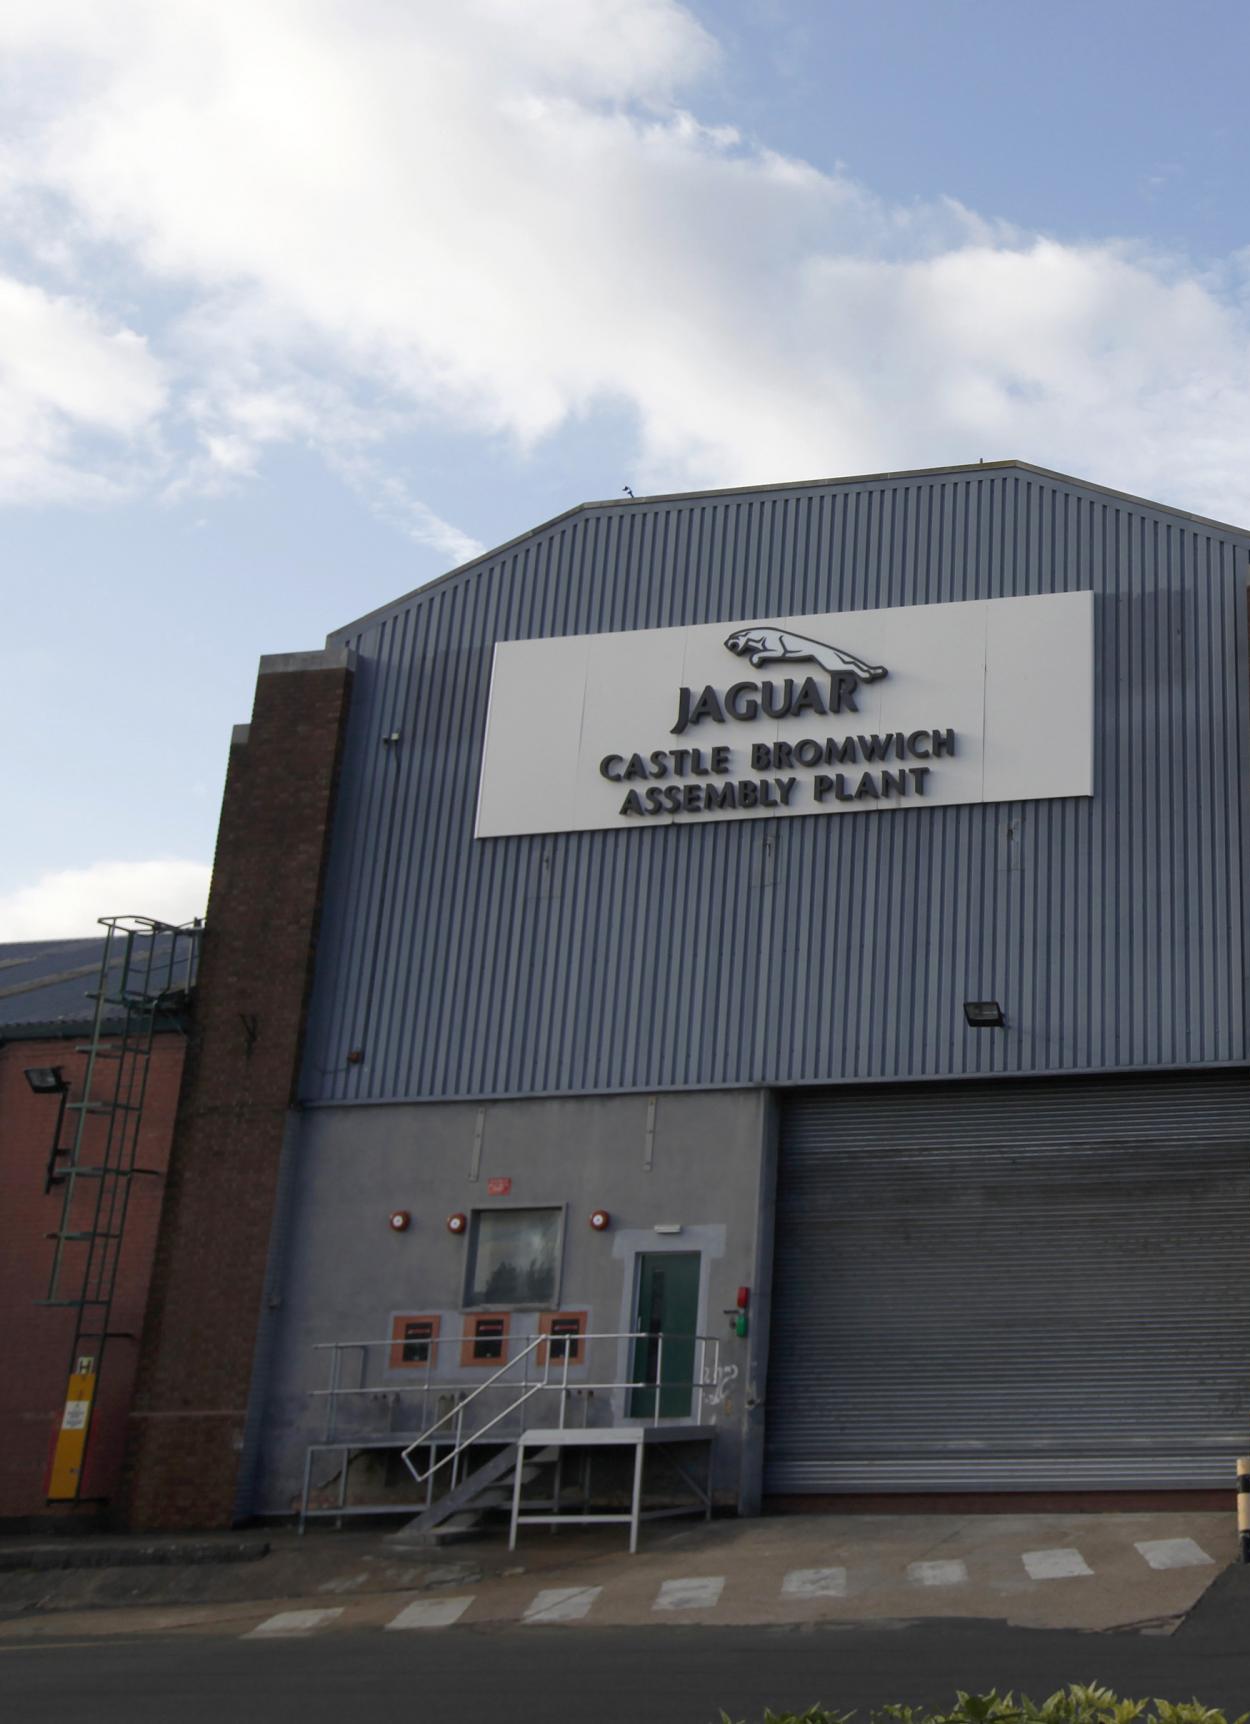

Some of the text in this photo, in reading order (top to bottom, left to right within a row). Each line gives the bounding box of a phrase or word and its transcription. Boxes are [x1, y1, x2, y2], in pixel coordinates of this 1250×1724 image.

[671, 673, 858, 734] JAGUAR
[600, 728, 955, 782] CASTLE BROMWICH
[619, 766, 930, 816] ASSEMBLY PLANT
